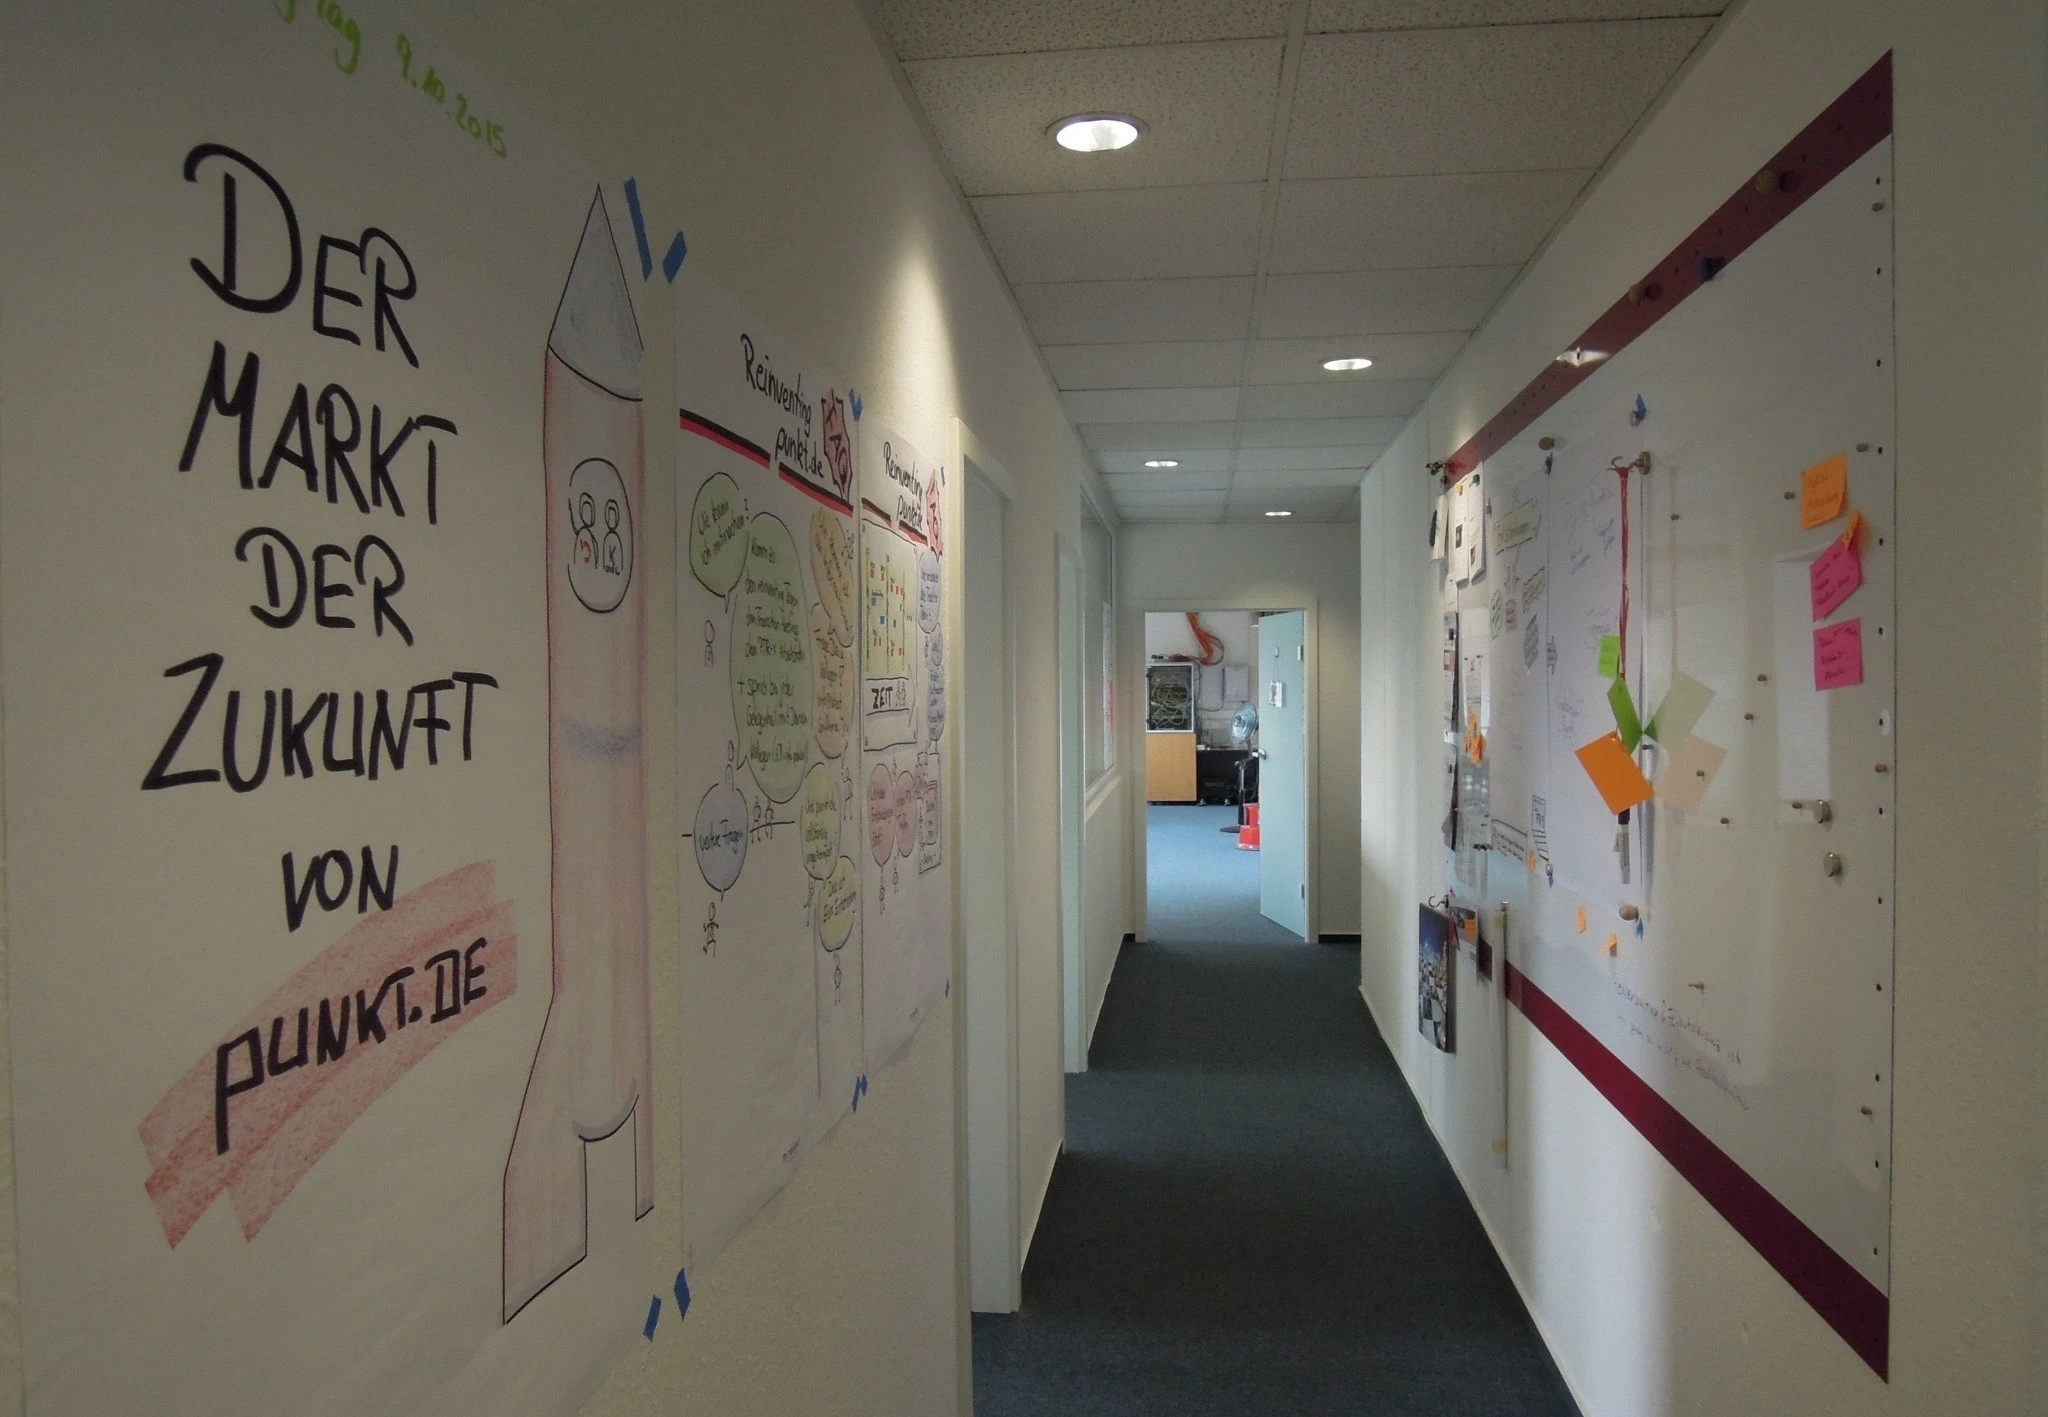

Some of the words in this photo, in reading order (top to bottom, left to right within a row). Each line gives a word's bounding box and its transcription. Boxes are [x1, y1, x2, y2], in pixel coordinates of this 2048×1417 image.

[184, 143, 419, 368] DER
[179, 341, 457, 525] MARKT
[740, 332, 812, 438] Reinventing
[775, 427, 824, 478] punkt.de
[883, 441, 923, 502] Reinventing
[236, 527, 413, 645] DER
[142, 653, 499, 792] ZUKUNFT
[871, 686, 894, 709] ZEIT
[282, 845, 398, 932] VON
